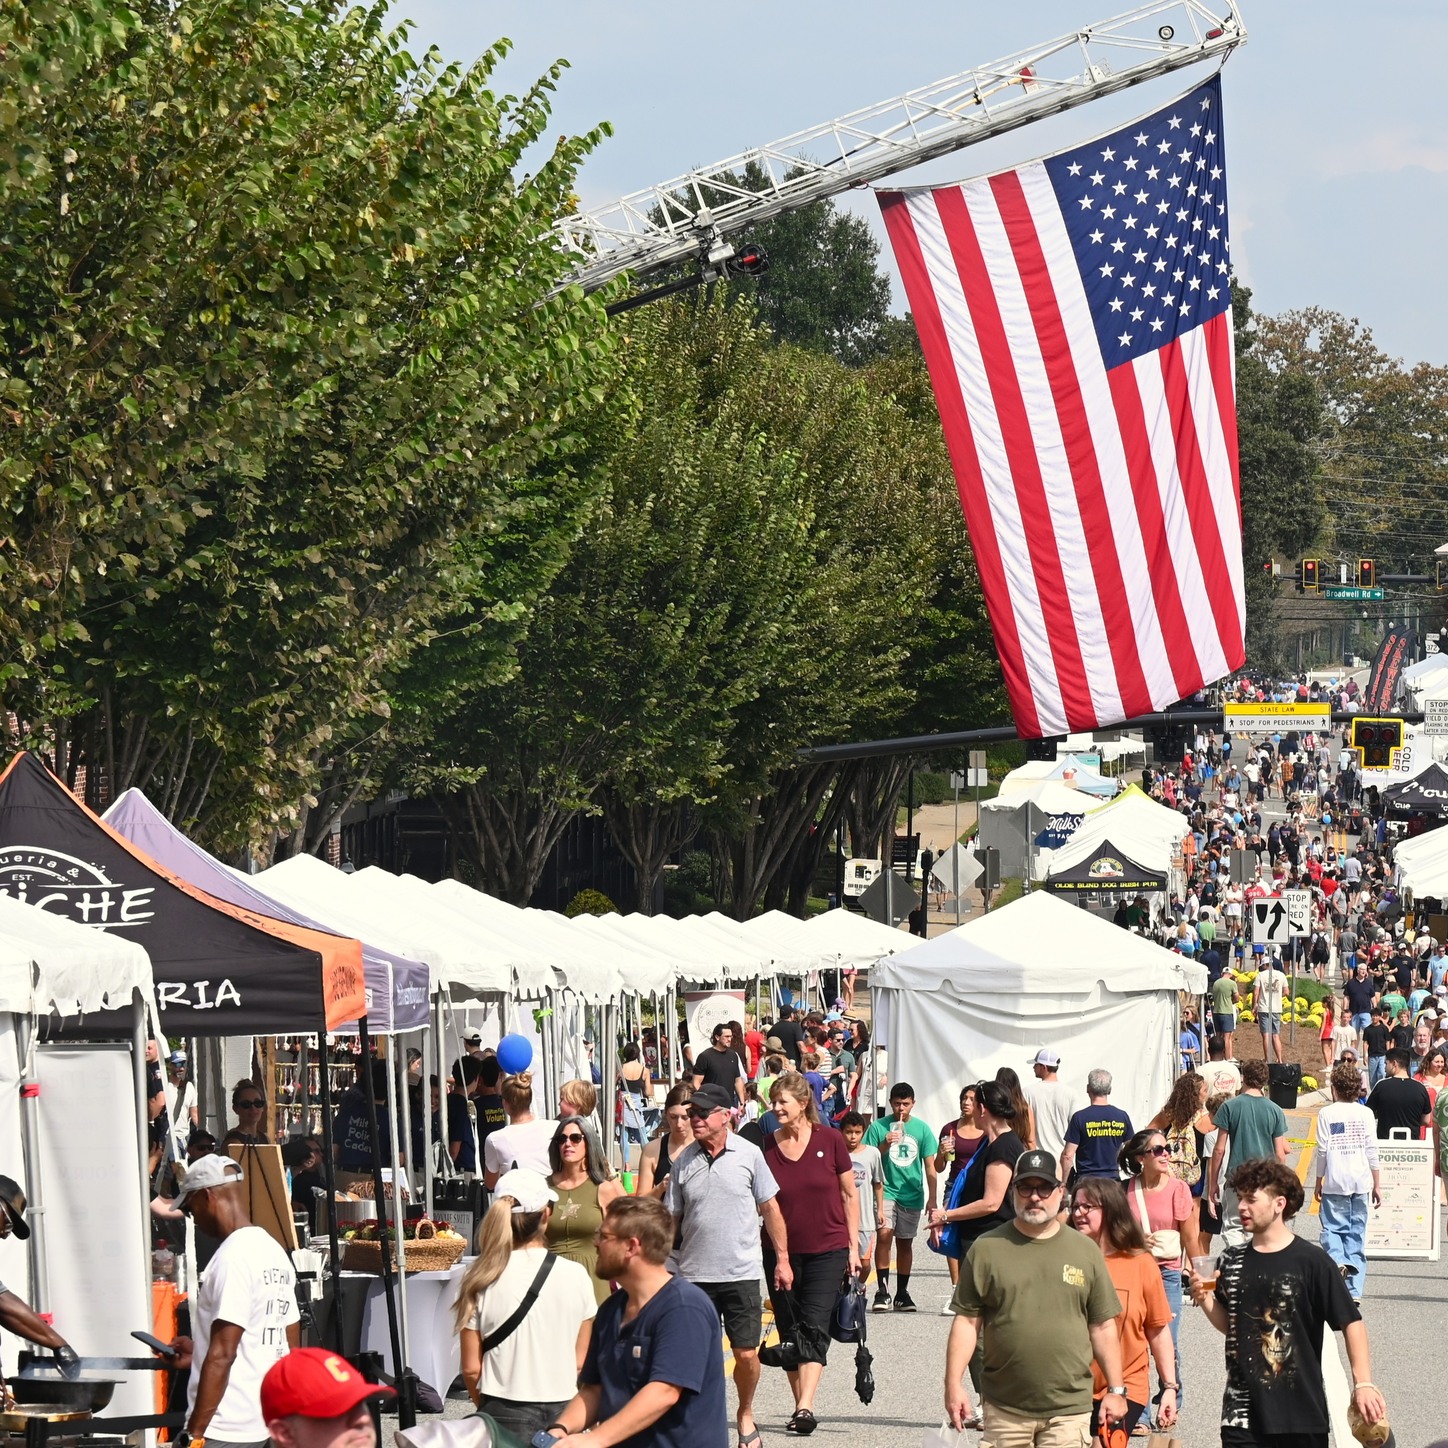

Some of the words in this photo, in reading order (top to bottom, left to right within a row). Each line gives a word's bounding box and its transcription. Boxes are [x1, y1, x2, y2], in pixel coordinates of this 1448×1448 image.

[1325, 589, 1359, 598] Broadwell
[1362, 589, 1371, 598] Rd
[1427, 643, 1438, 651] 372
[1392, 749, 1401, 771] EER
[1401, 746, 1411, 773] COLD
[145, 978, 242, 1010] RIA
[1112, 1120, 1125, 1128] Corps
[348, 1127, 371, 1141] Polic
[1086, 1128, 1124, 1138] Volunteer
[897, 1144, 909, 1158] R
[324, 1356, 350, 1382] C
